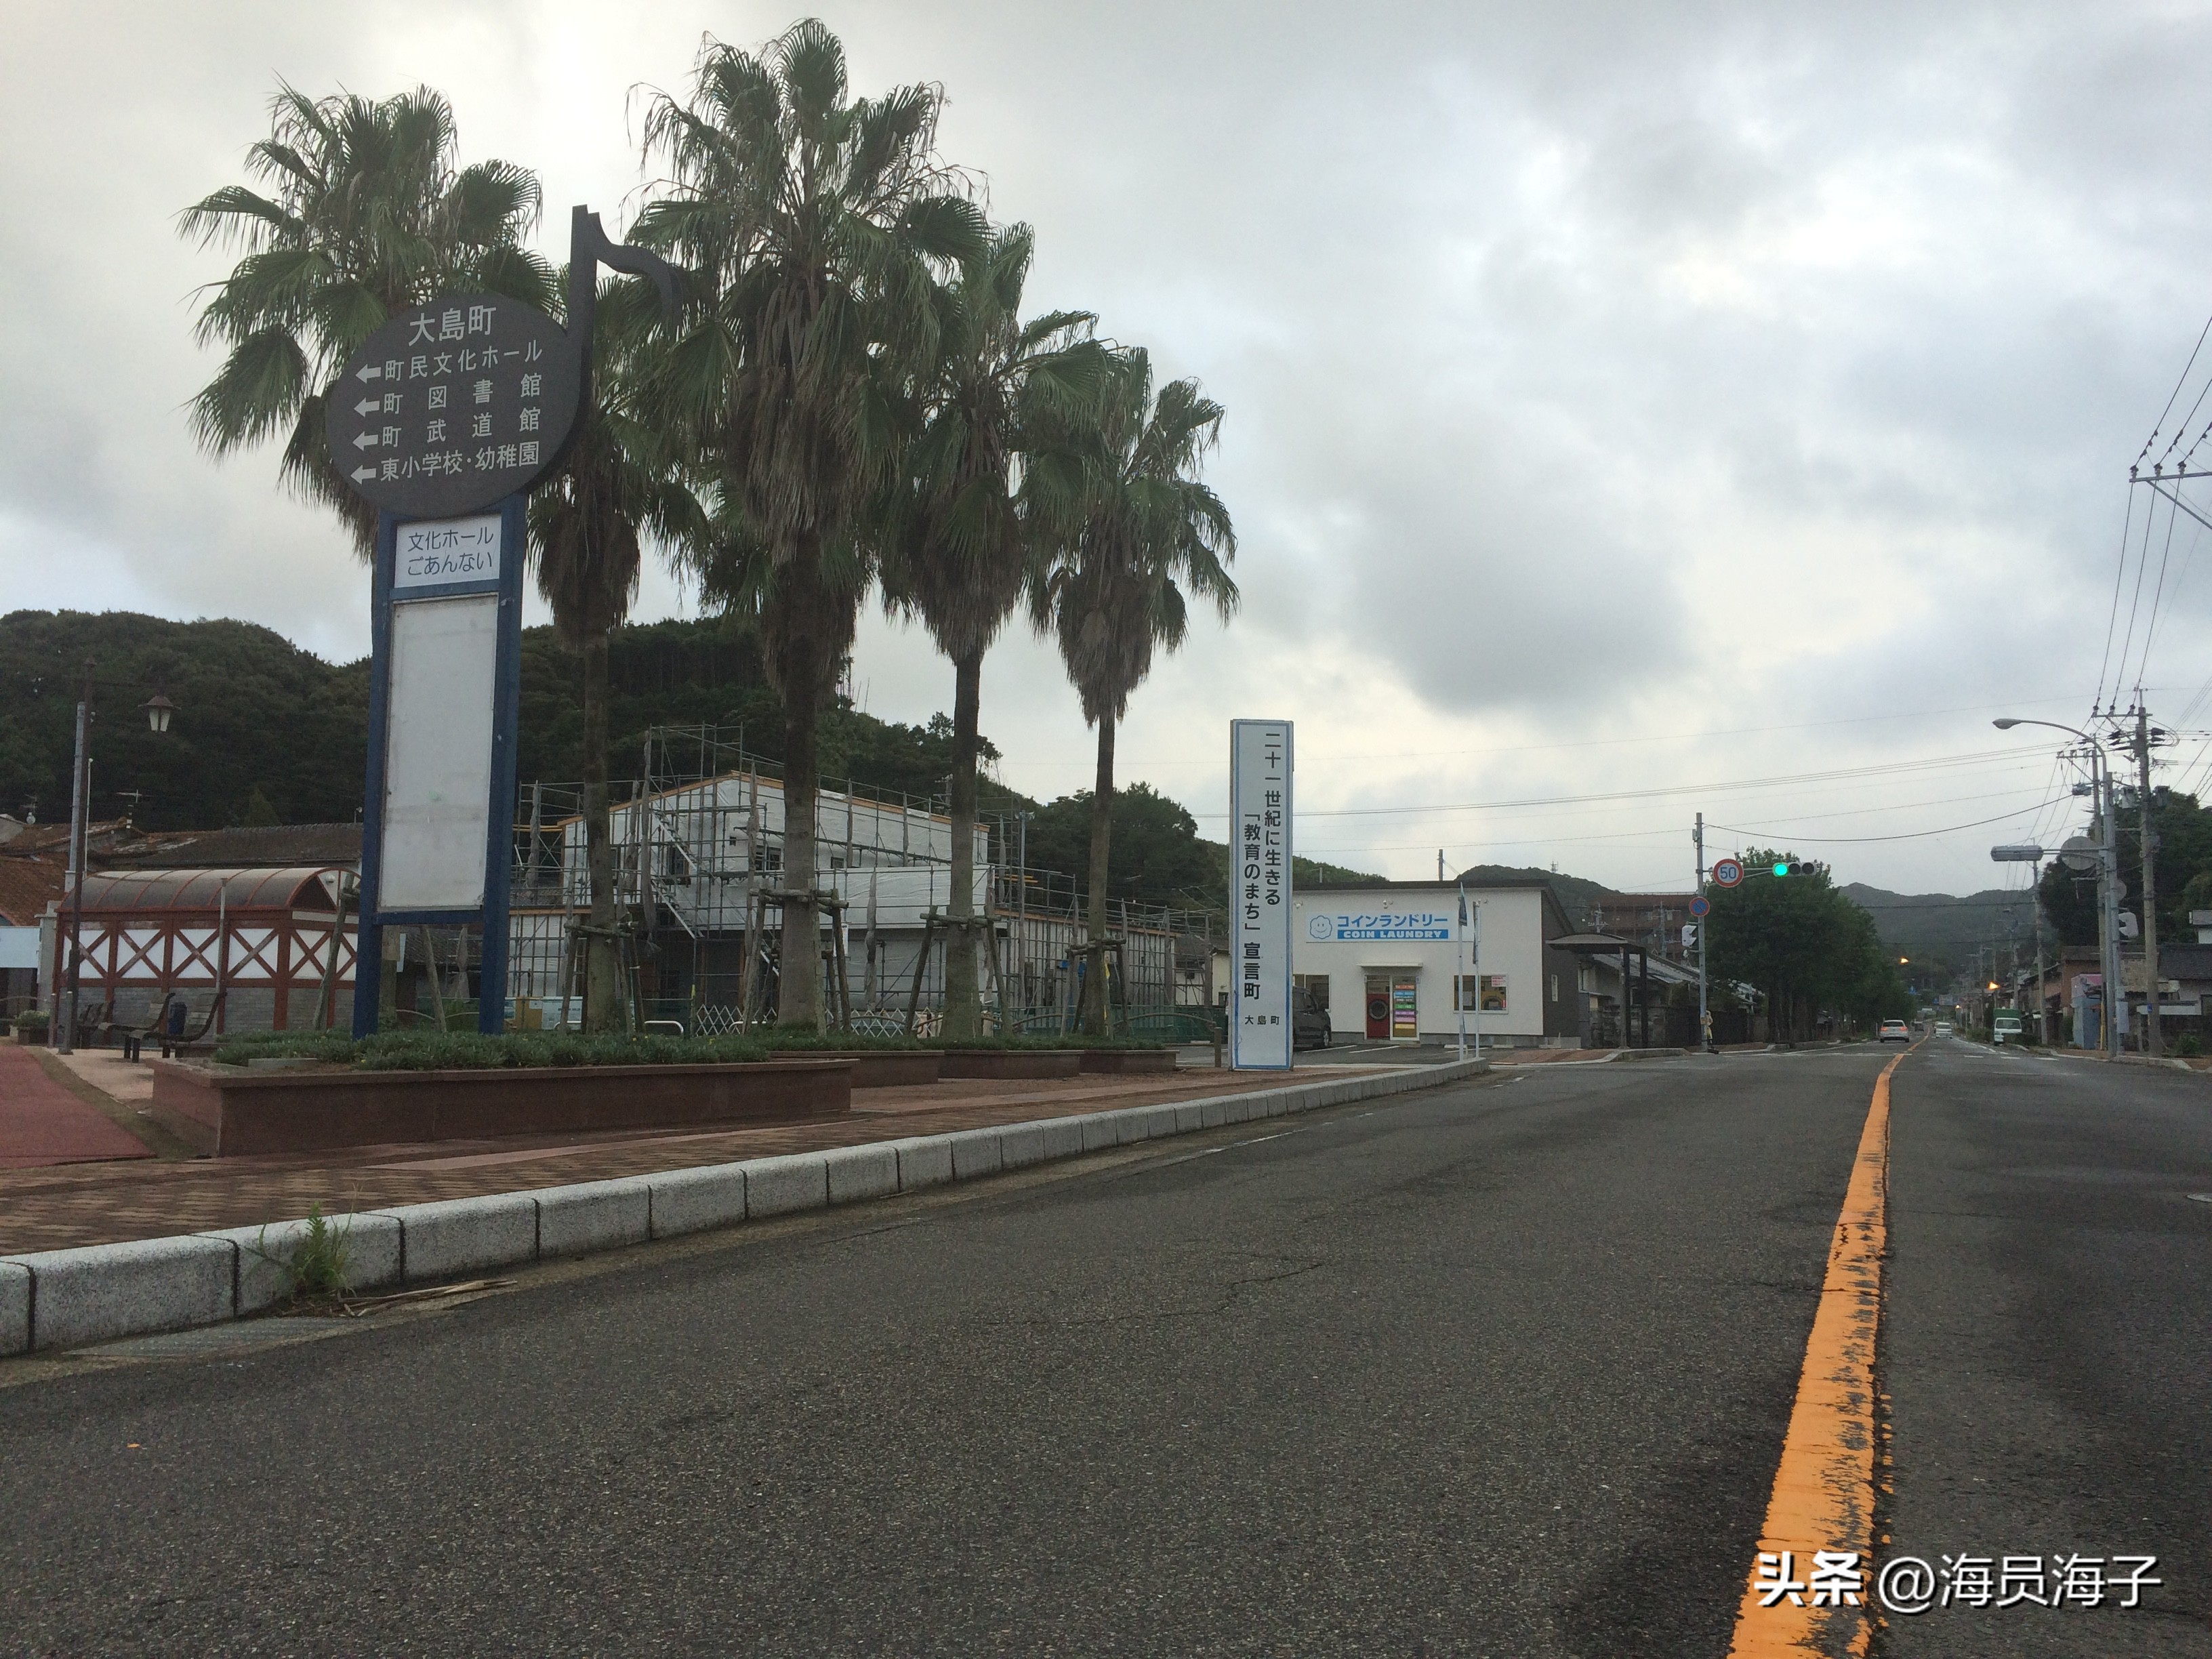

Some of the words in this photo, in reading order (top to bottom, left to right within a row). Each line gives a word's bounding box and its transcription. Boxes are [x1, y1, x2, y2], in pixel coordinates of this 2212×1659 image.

[408, 305, 497, 347] 大島町
[384, 340, 543, 382] 町民文化ホール
[383, 373, 542, 414] 町図書館
[382, 407, 541, 447] 町武道館
[380, 441, 539, 483] 東小学校・幼稚園
[407, 527, 494, 552] 文化ホール
[407, 551, 493, 577] ごあんない
[1264, 733, 1282, 906] 二十一世紀に生きる
[1720, 867, 1737, 879] 50
[1243, 813, 1261, 1000] 「教育のまち」宣言町
[1337, 914, 1448, 928] コインランドリー
[1343, 930, 1376, 939] COIN
[1380, 930, 1443, 939] LAUNDRY
[1244, 1015, 1280, 1025] 大島町
